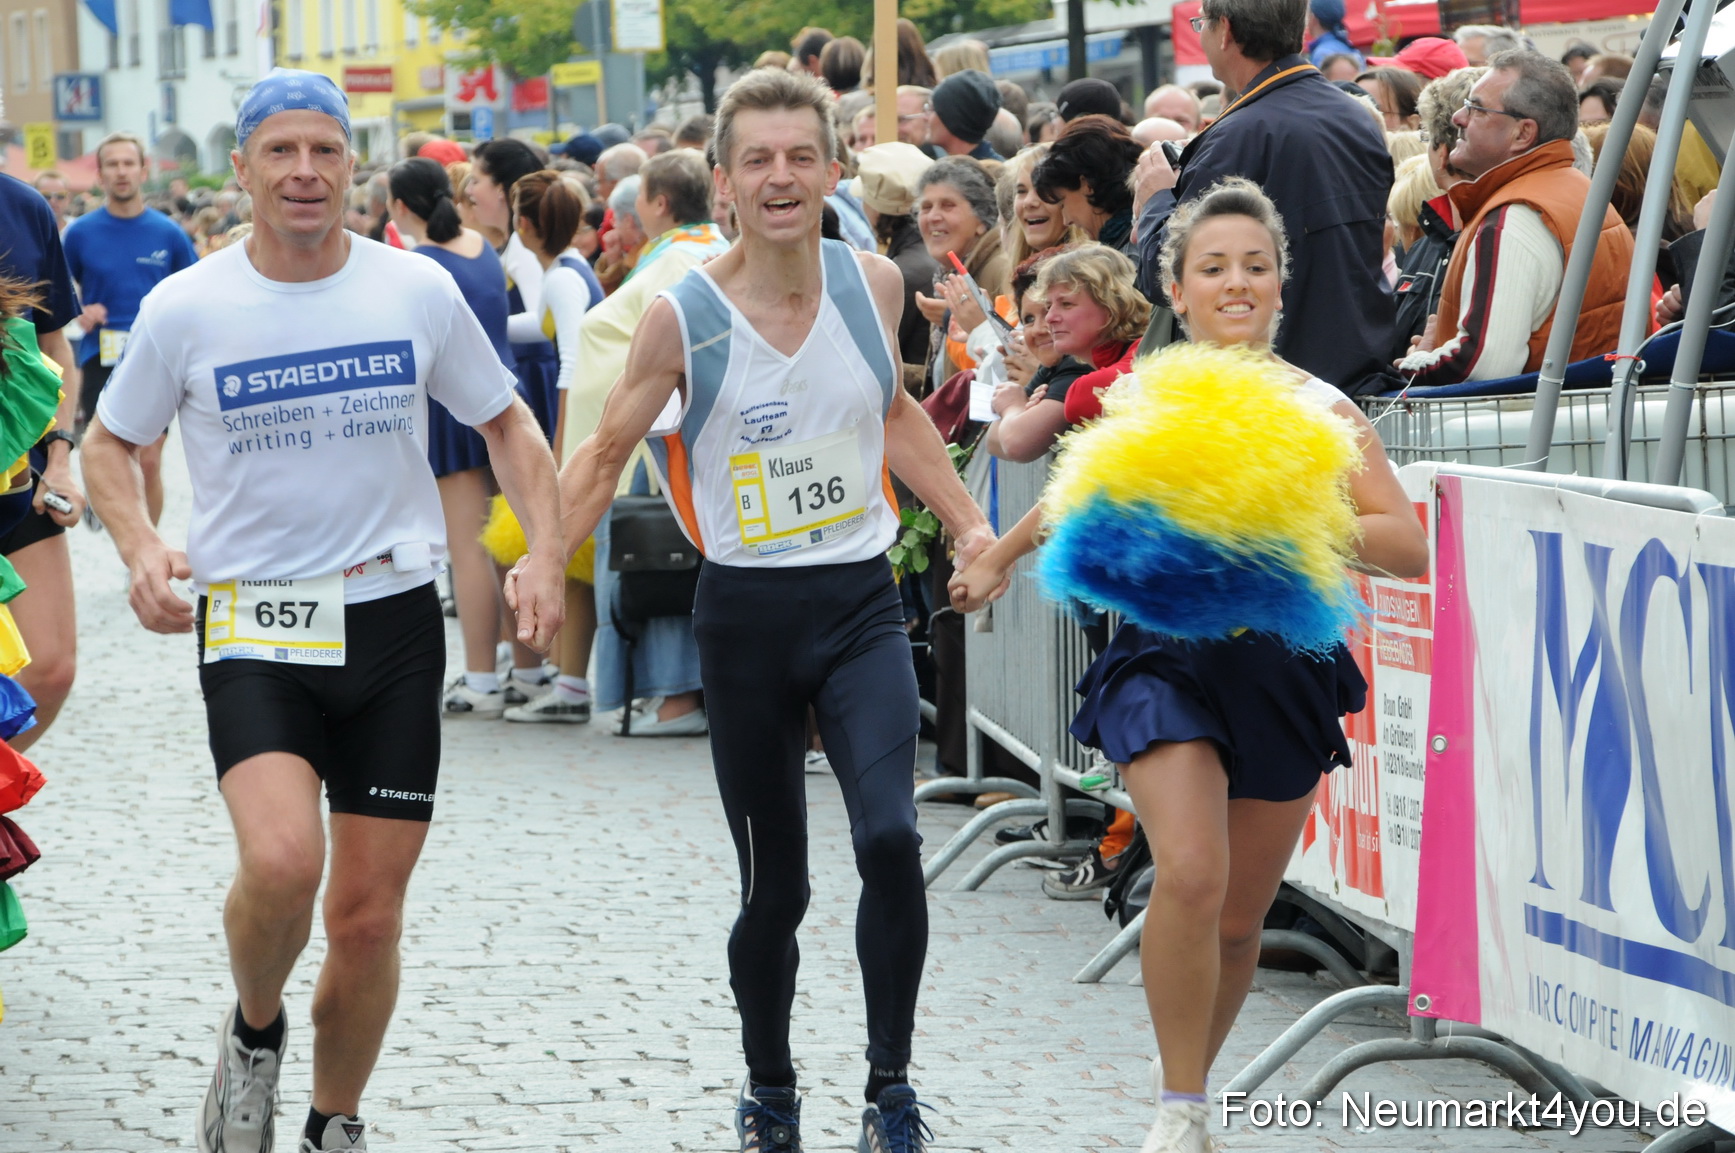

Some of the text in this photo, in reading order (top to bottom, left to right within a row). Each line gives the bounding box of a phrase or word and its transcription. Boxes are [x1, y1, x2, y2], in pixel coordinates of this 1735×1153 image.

[223, 391, 415, 432] Schreiben + Zeichnen
[744, 410, 787, 425] Laufteam
[228, 413, 413, 455] writing + drawing
[768, 457, 813, 479] Klaus
[741, 495, 751, 510] B
[788, 476, 845, 515] 136
[823, 513, 865, 535] PFLEIDERER
[212, 600, 221, 613] B
[255, 601, 319, 629] 657
[290, 648, 343, 659] PFLEIDERER
